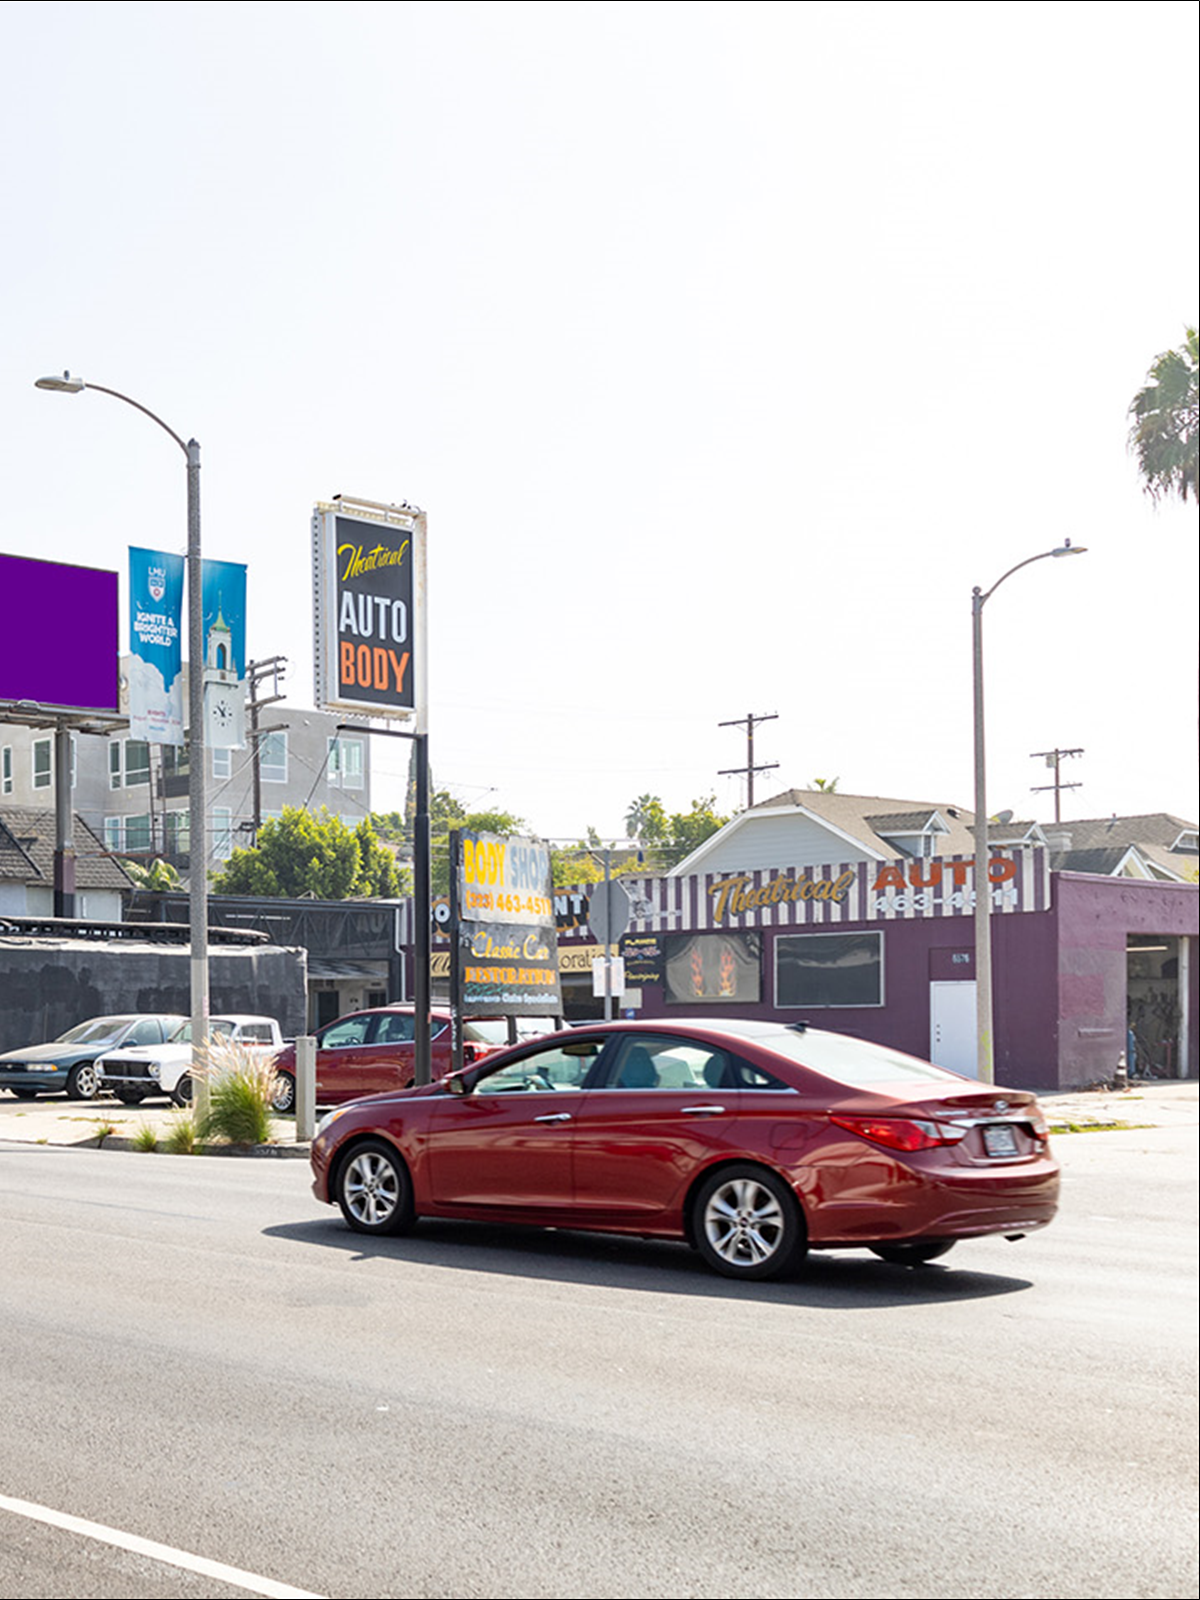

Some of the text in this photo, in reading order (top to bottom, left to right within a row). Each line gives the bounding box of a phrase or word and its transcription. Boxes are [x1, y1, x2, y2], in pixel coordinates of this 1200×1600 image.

[148, 566, 166, 577] LMU
[337, 539, 409, 581] Theatrical
[133, 621, 178, 637] BRIGHTER
[136, 611, 174, 627] IGNITE A
[339, 590, 407, 643] AUTO
[139, 632, 172, 647] WORLD
[340, 640, 410, 693] BODY
[463, 839, 548, 891] BODY SHOP
[707, 857, 1017, 923] Theatrical AUTO
[470, 931, 520, 959] Classic
[523, 934, 550, 960] Car
[464, 966, 556, 985] RESTORATION
